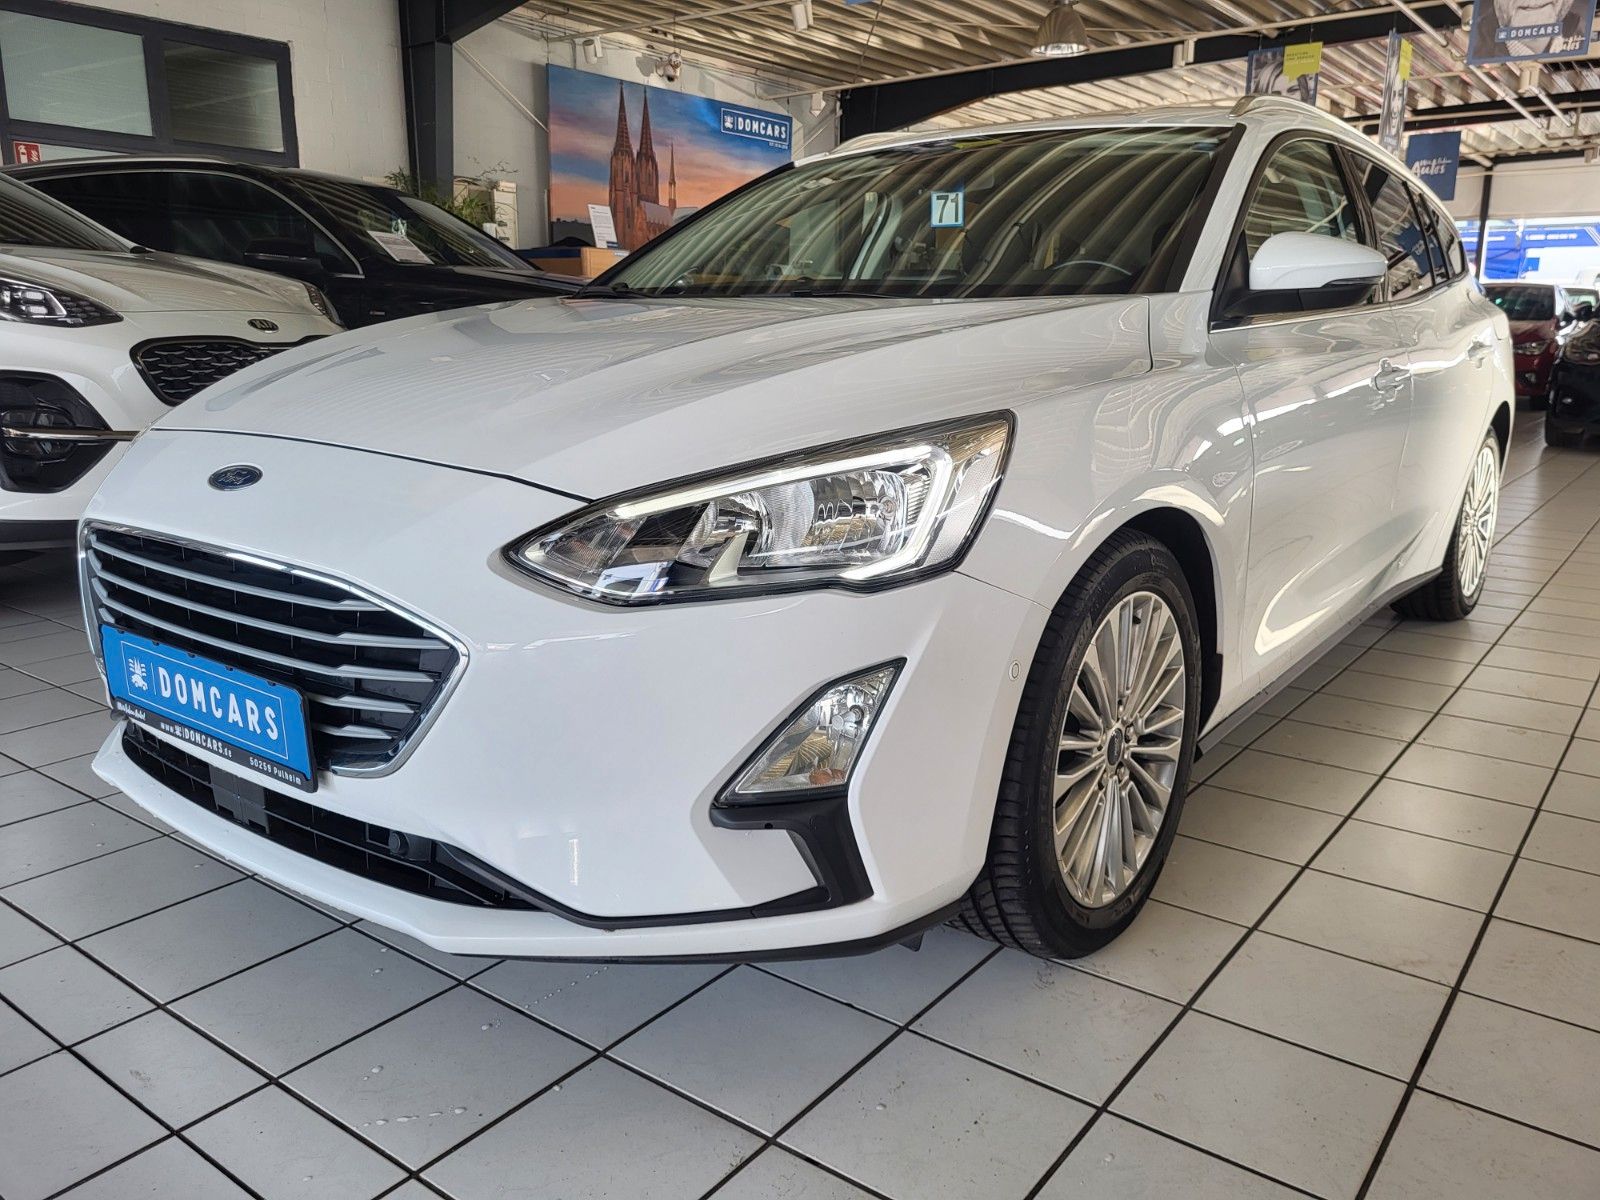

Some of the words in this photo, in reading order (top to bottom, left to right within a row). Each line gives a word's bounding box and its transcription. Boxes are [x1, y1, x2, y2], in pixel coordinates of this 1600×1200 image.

[1510, 25, 1560, 38] DOMCARS
[738, 117, 786, 139] DOMCARS
[936, 193, 959, 224] 71
[158, 667, 279, 740] DOMCARS
[249, 756, 272, 773] 50259
[273, 766, 302, 785] Pulheim
